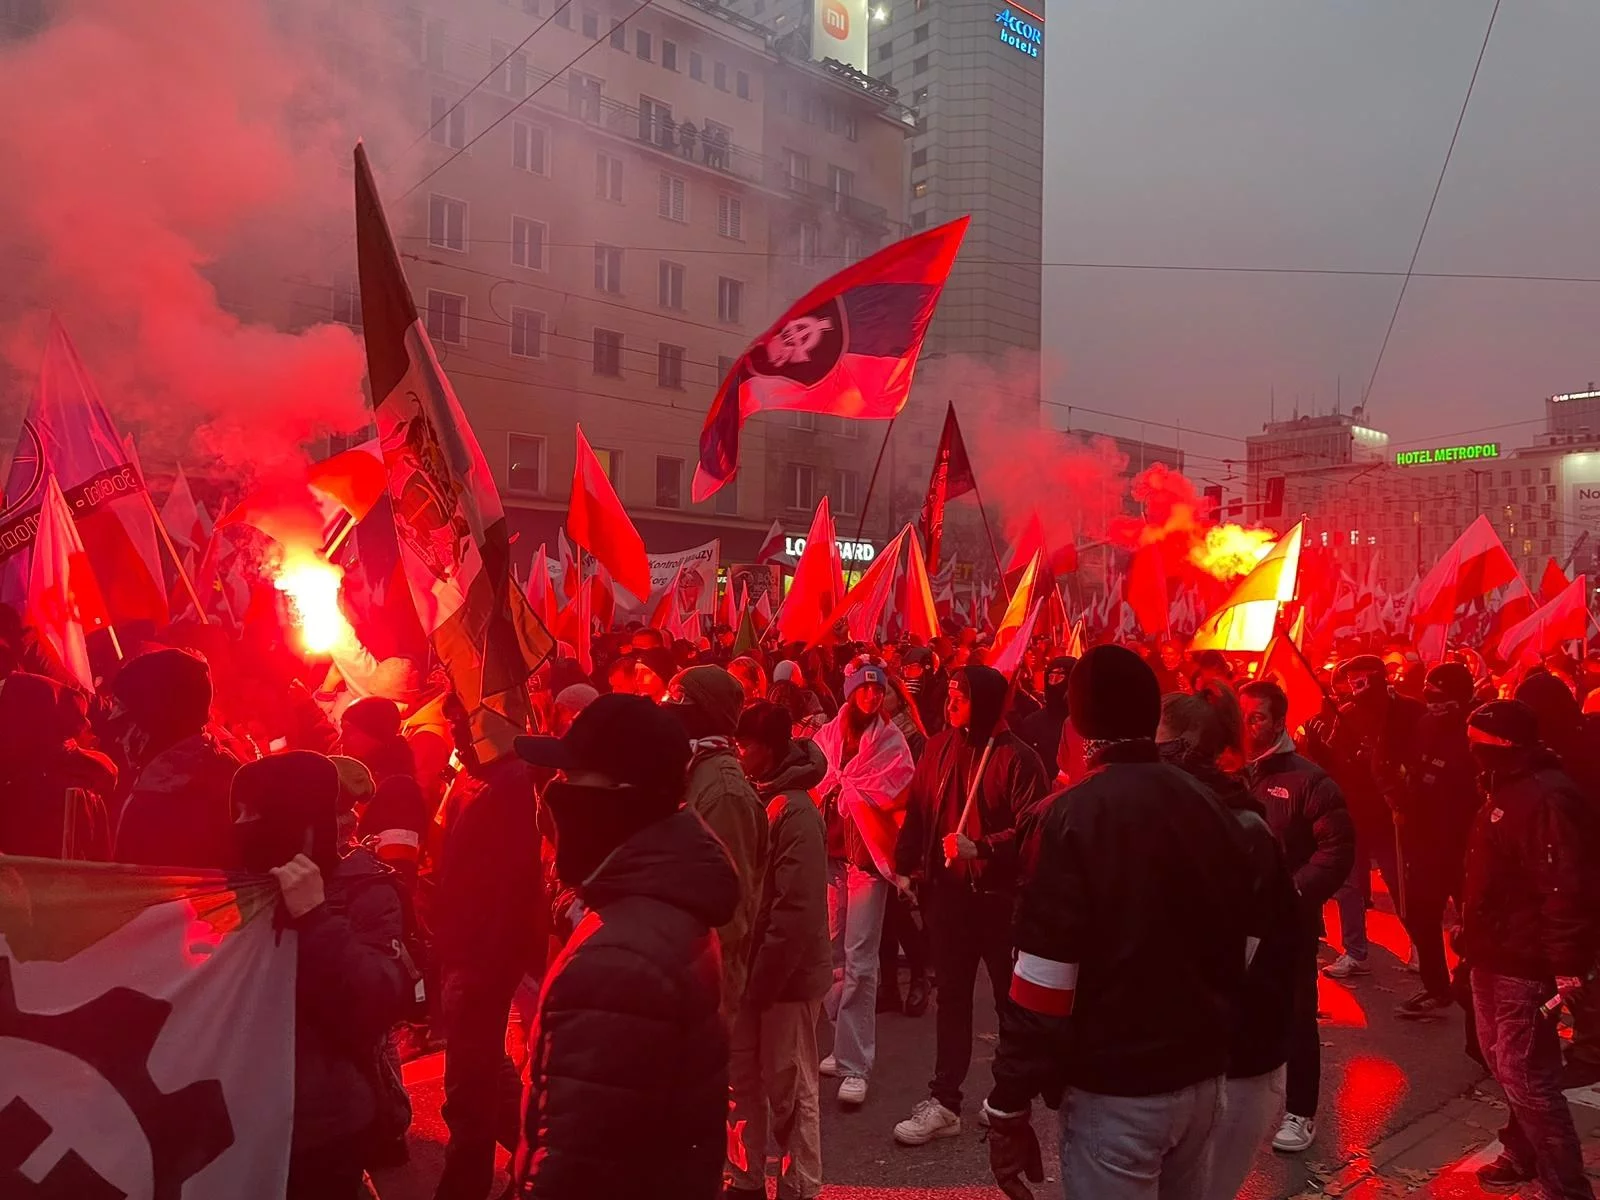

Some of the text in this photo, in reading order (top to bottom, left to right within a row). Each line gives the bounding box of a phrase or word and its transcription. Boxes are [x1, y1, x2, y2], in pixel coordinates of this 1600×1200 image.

[1000, 29, 1038, 58] hotels
[1397, 444, 1498, 465] HOTEL METROPOL
[785, 537, 875, 561] LOARD
